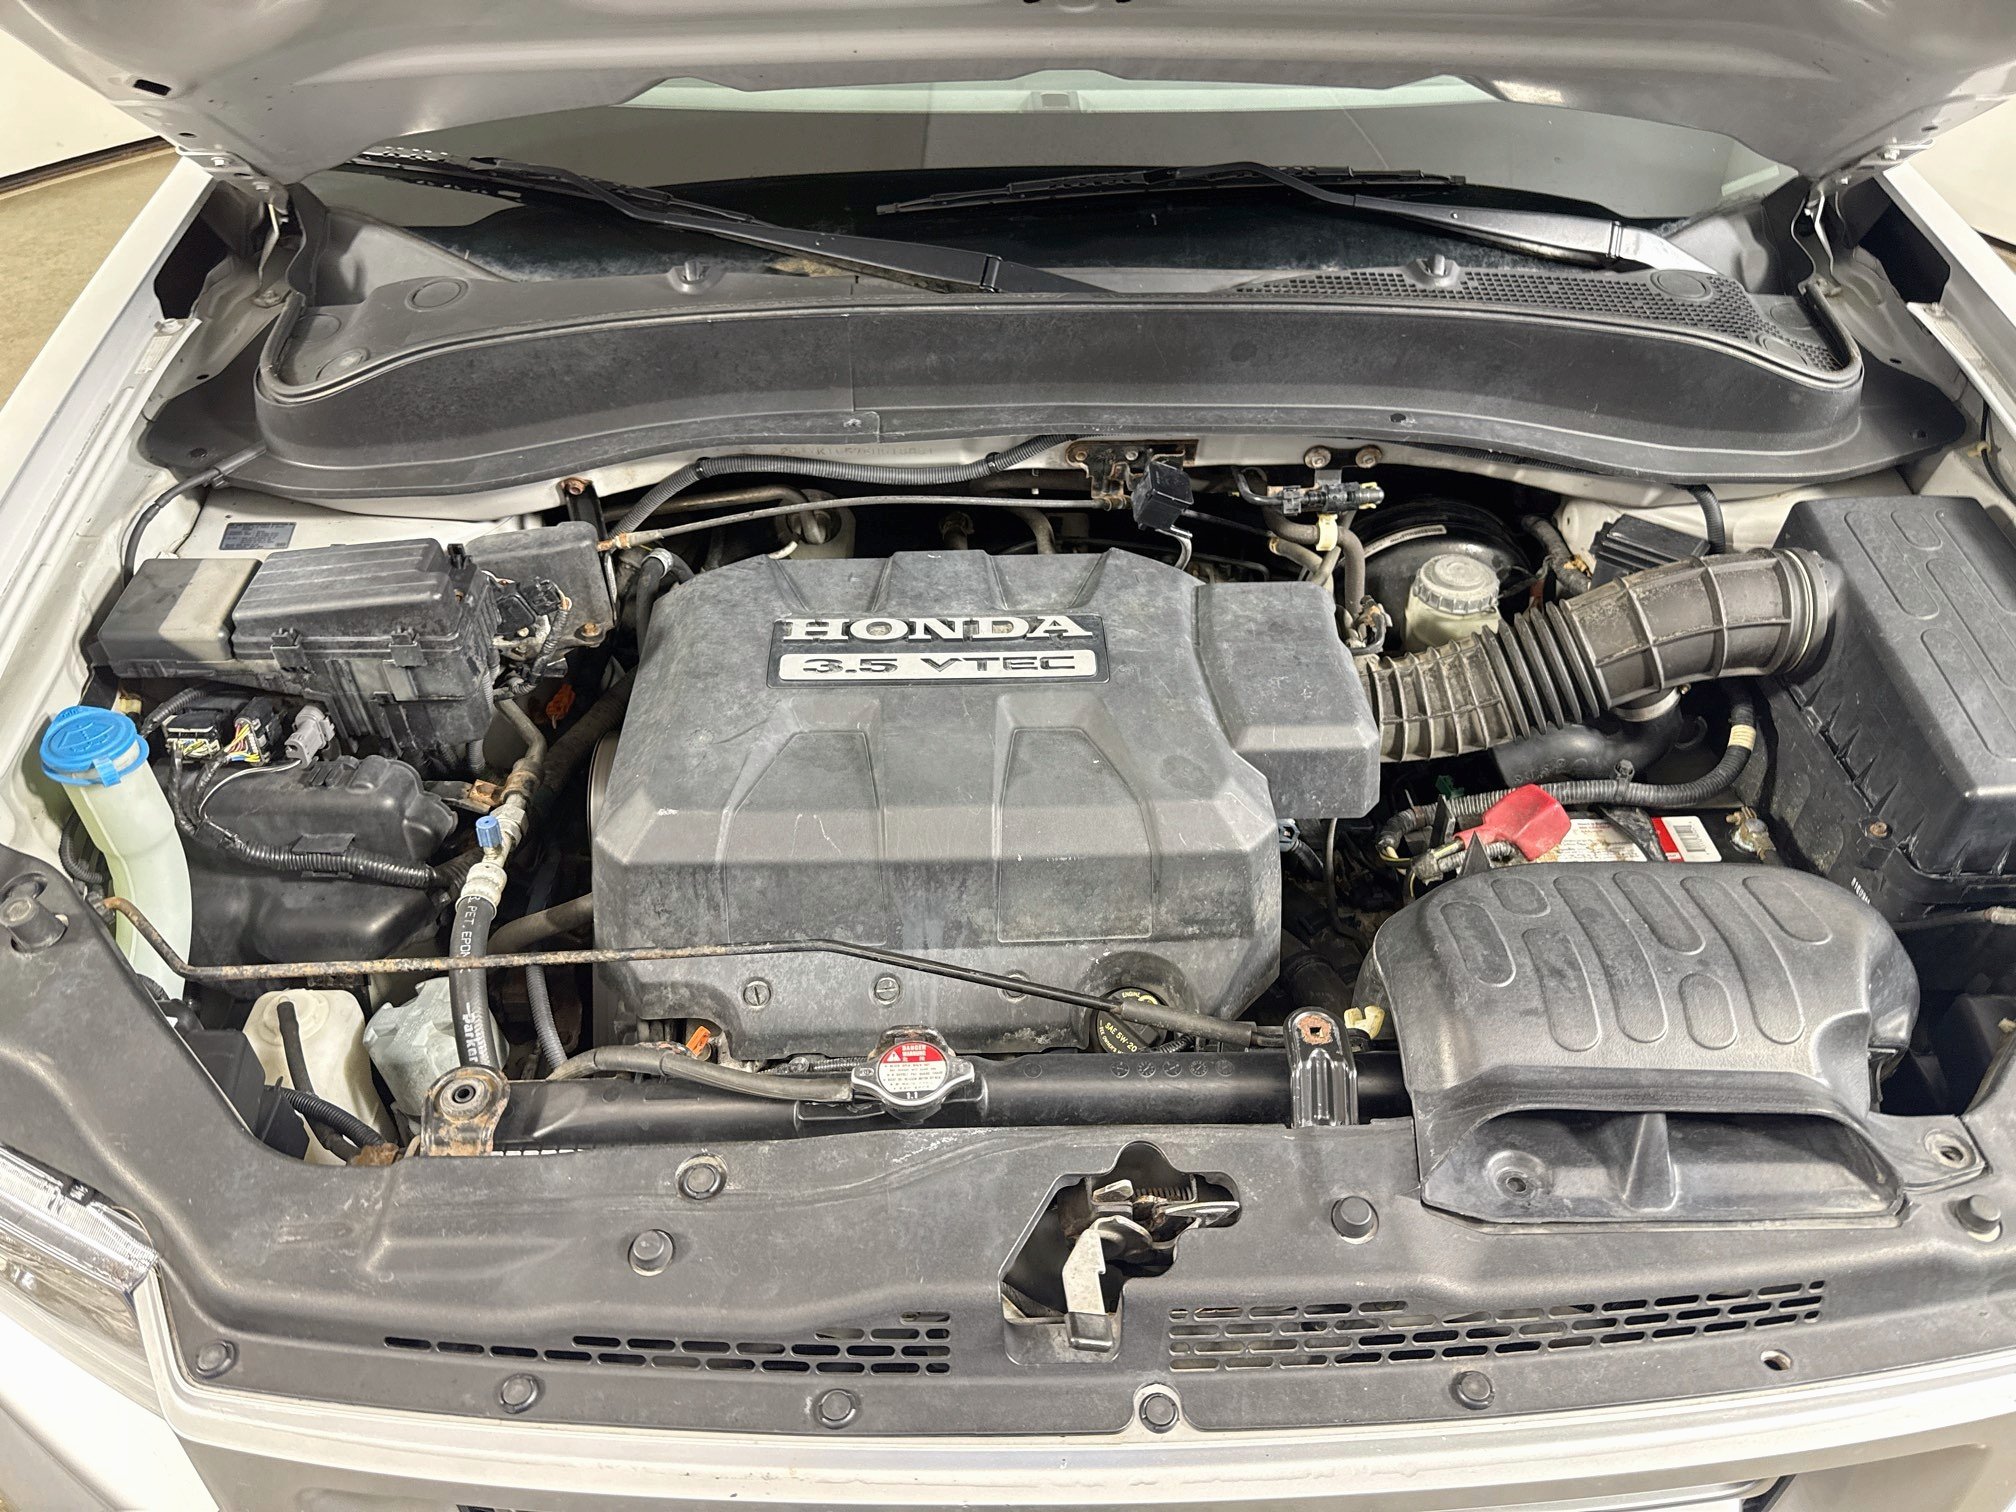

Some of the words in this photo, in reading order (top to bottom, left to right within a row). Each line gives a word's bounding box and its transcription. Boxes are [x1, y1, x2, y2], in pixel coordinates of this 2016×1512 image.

[783, 615, 1093, 641] HONDA
[803, 658, 898, 674] 3.5
[920, 655, 1076, 673] VTEC
[1104, 1022, 1118, 1035] SAE
[1115, 1032, 1138, 1053] 5W-20
[906, 1091, 918, 1099] 1.1
